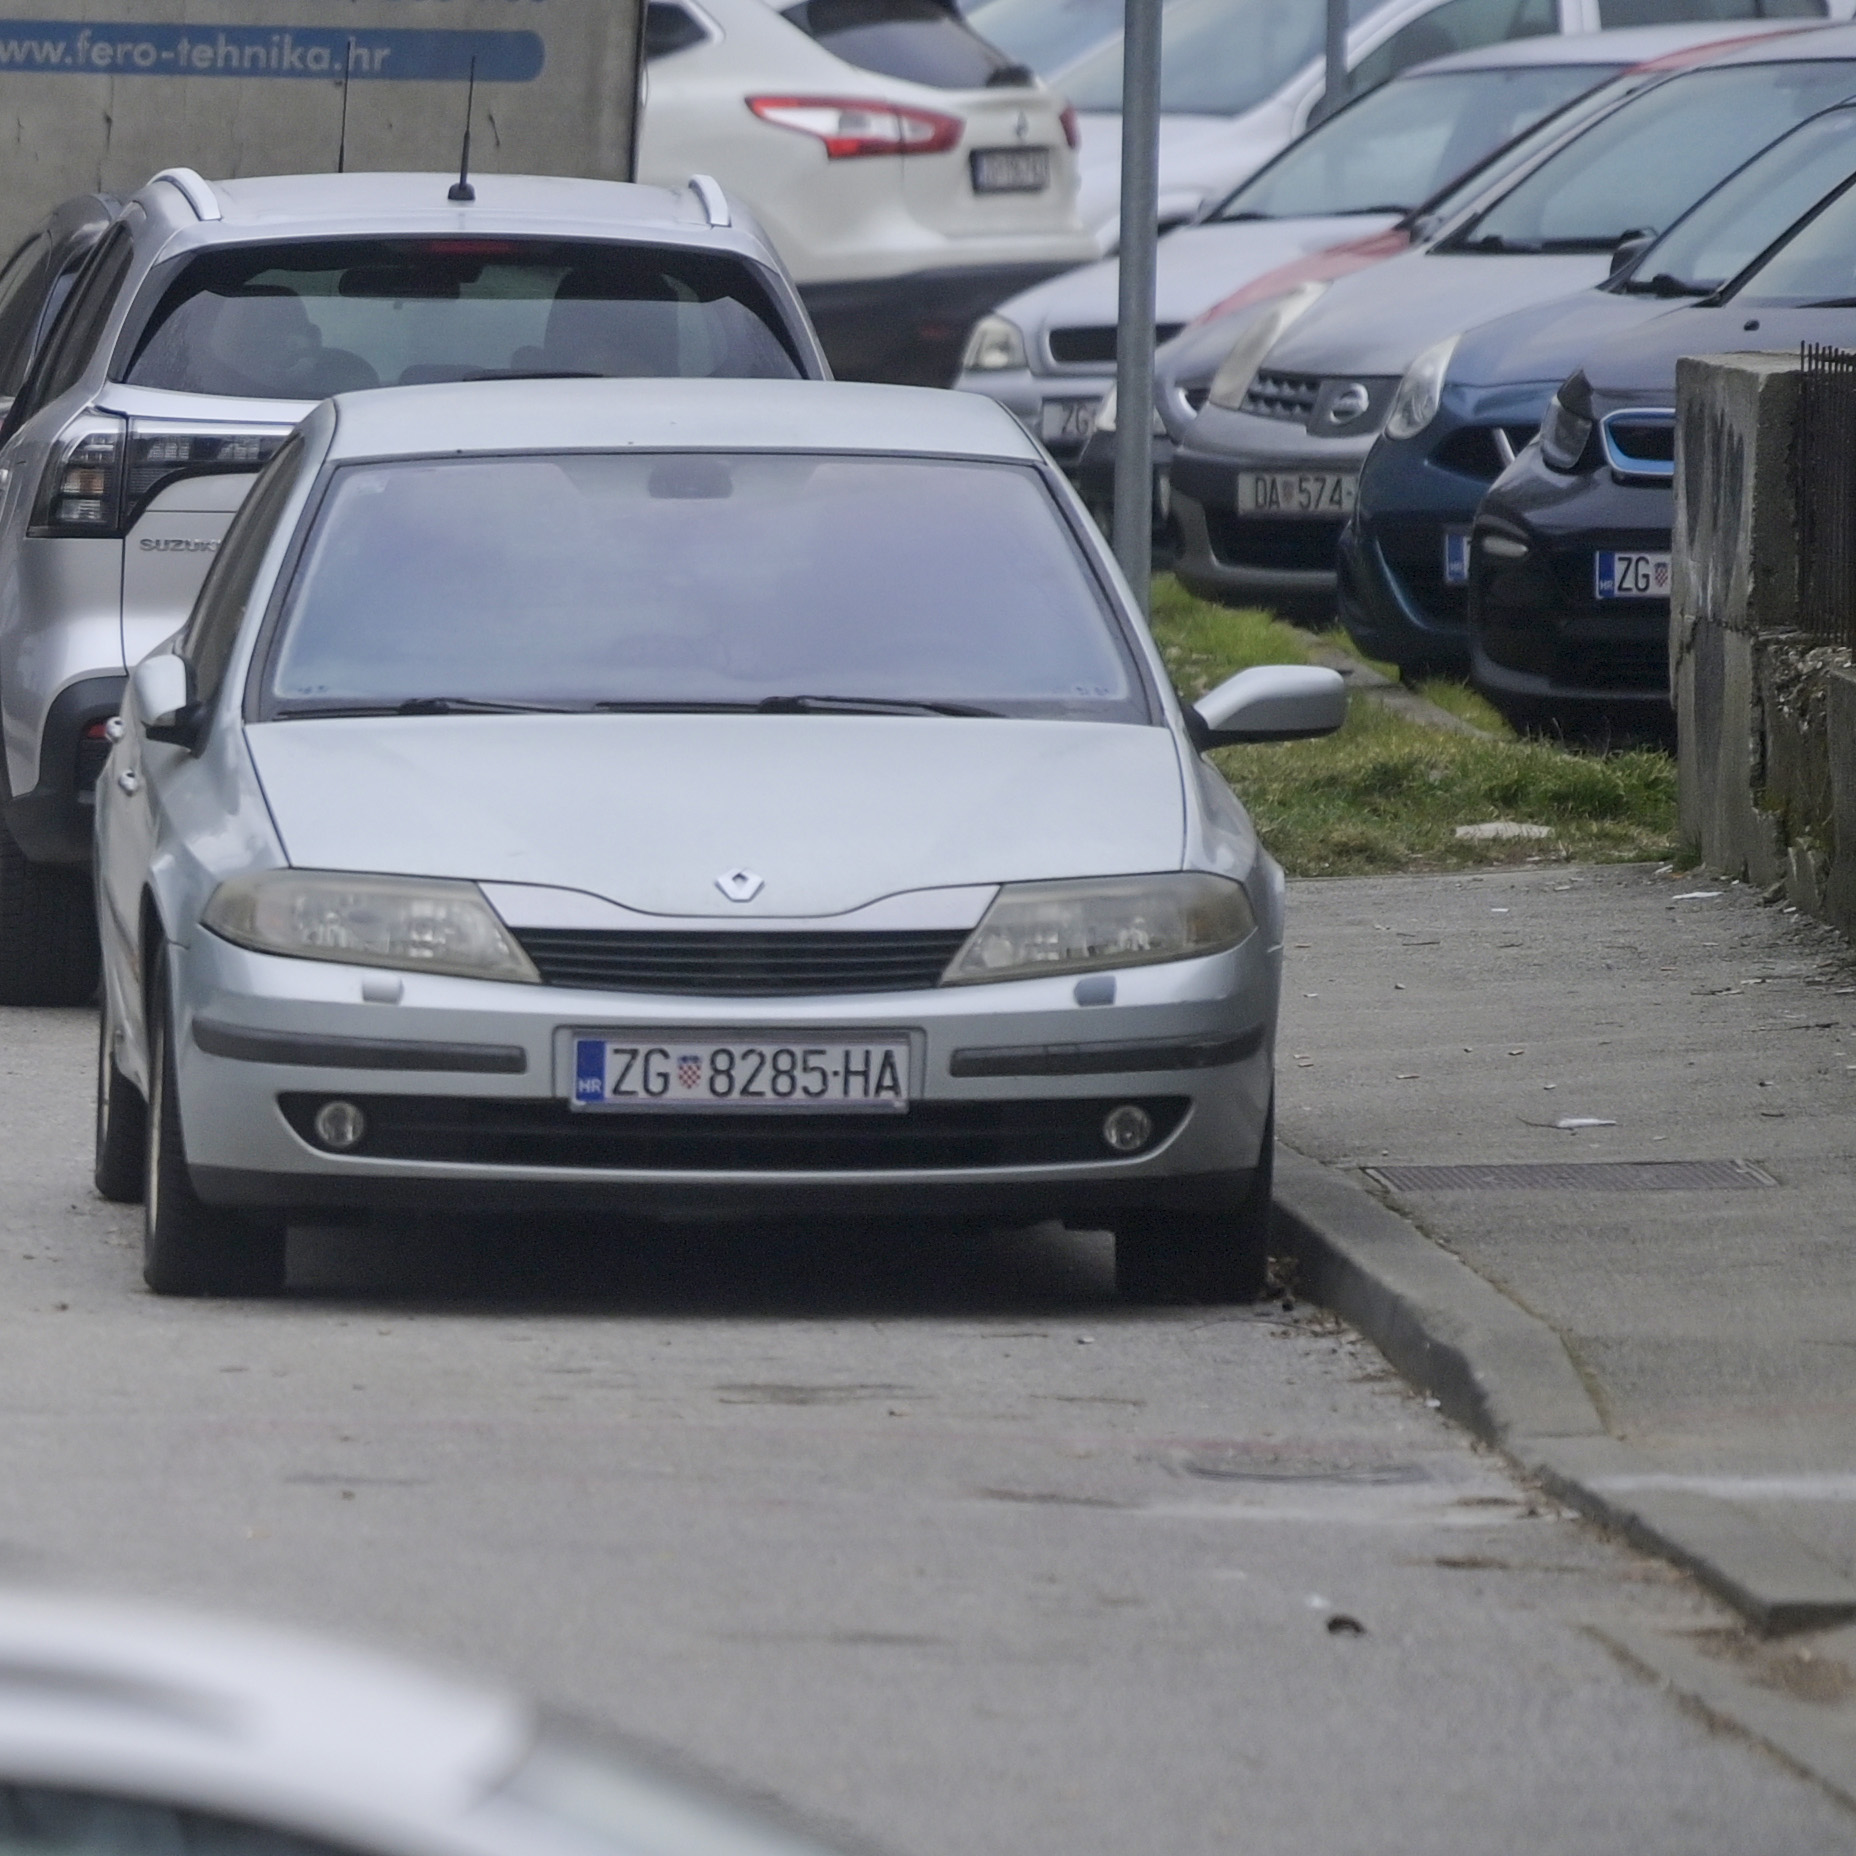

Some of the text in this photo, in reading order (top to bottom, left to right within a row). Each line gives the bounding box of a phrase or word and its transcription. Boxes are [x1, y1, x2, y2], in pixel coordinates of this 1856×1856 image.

[1255, 477, 1281, 509] DA
[1617, 556, 1650, 592] ZG
[579, 1078, 603, 1093] HR
[611, 1047, 671, 1099] ZG
